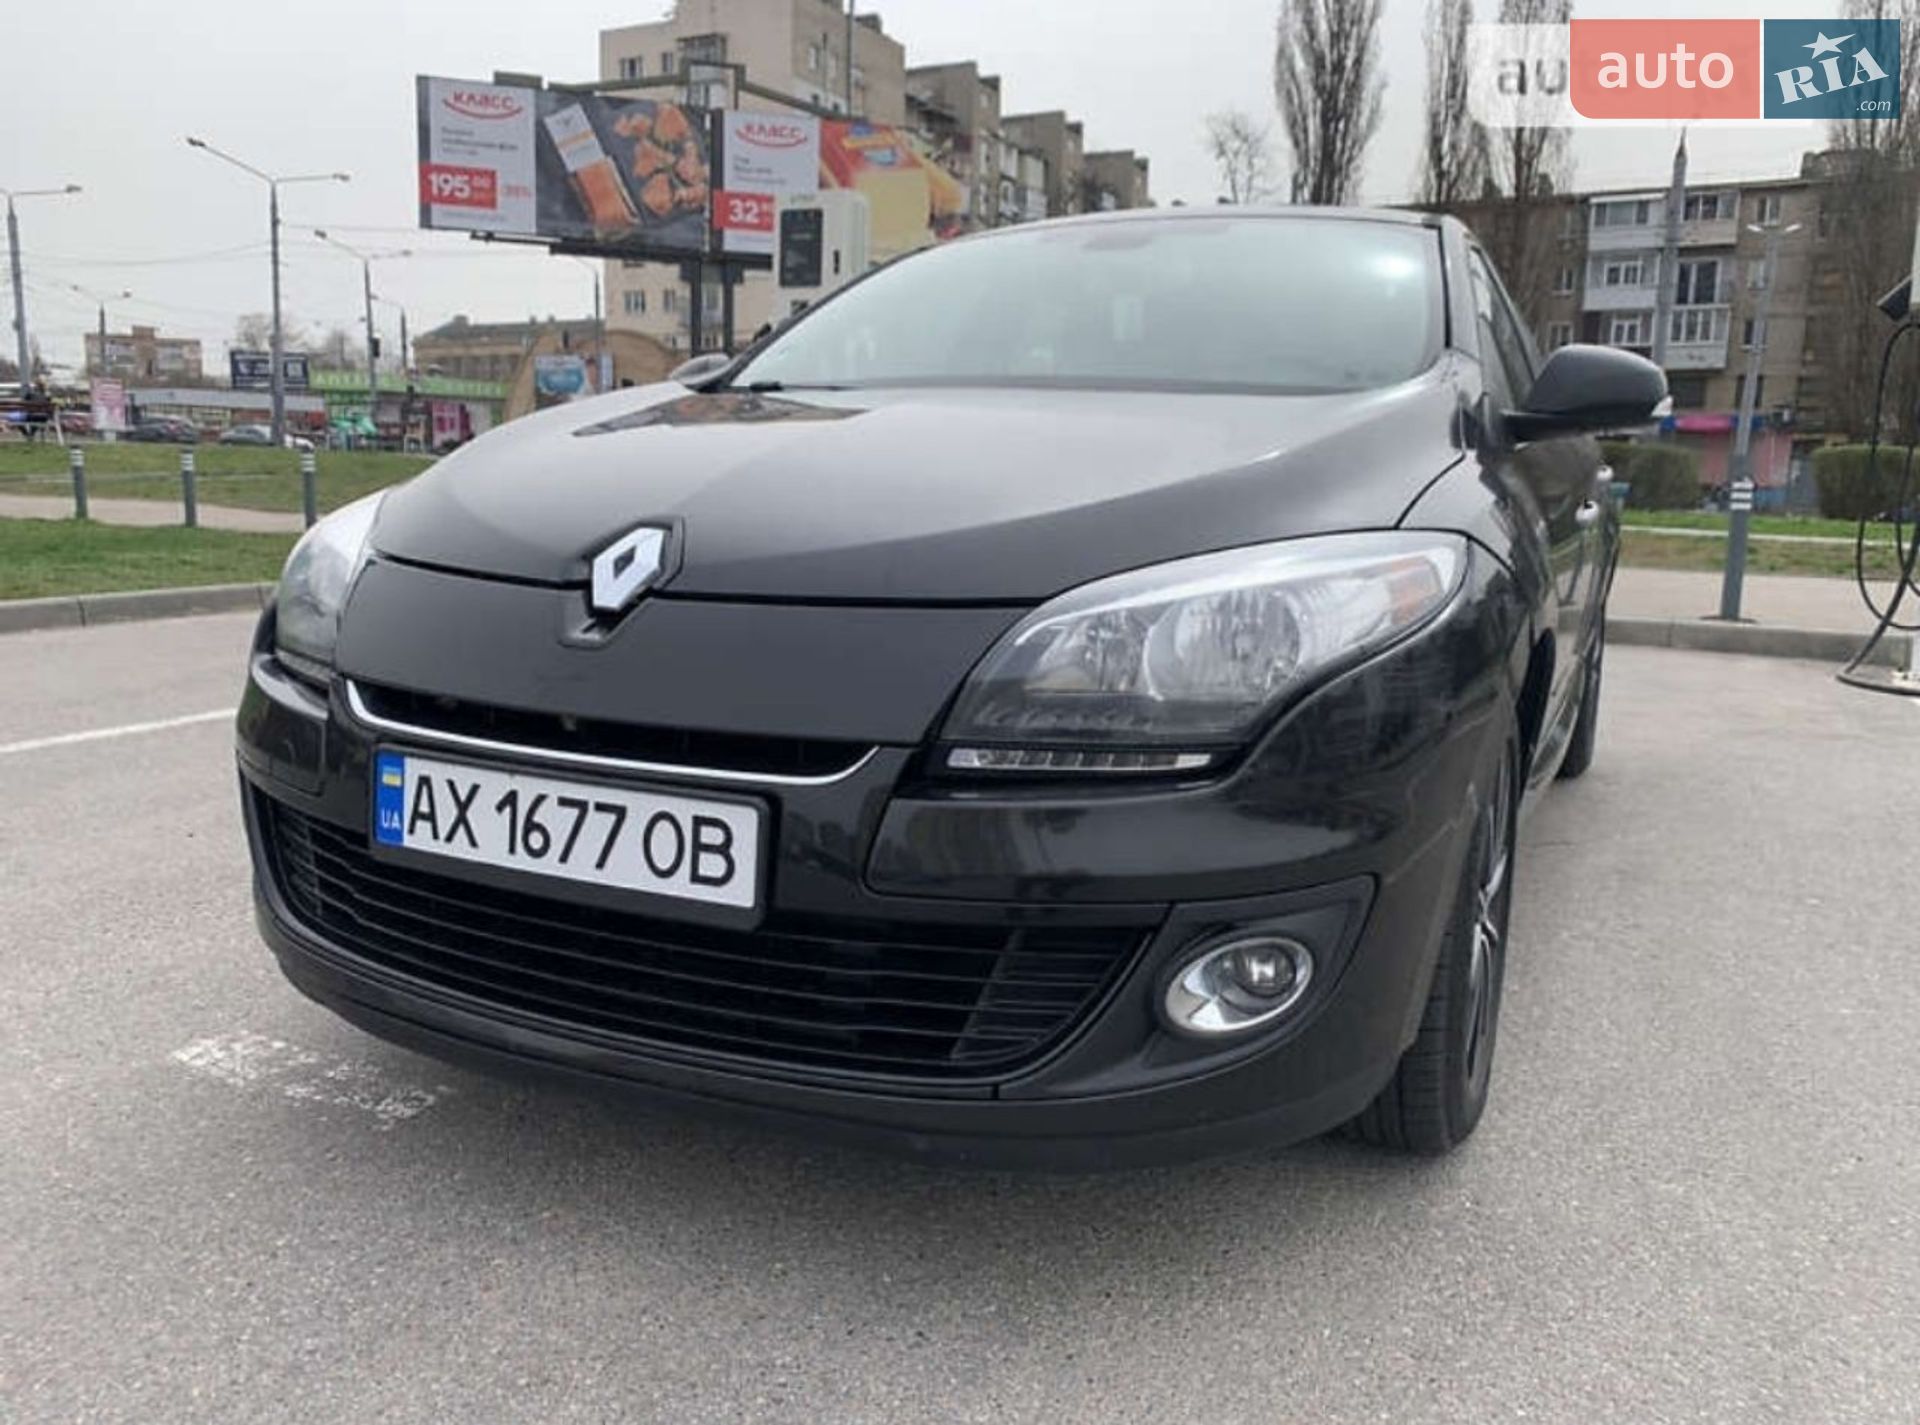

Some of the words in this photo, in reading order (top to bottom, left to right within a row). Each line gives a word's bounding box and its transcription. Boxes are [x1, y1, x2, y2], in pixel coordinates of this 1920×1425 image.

[428, 171, 471, 199] 195
[728, 198, 760, 225] 32
[381, 808, 402, 830] UA
[408, 774, 481, 848] AX
[495, 788, 628, 872] 1677
[642, 810, 737, 888] OB
